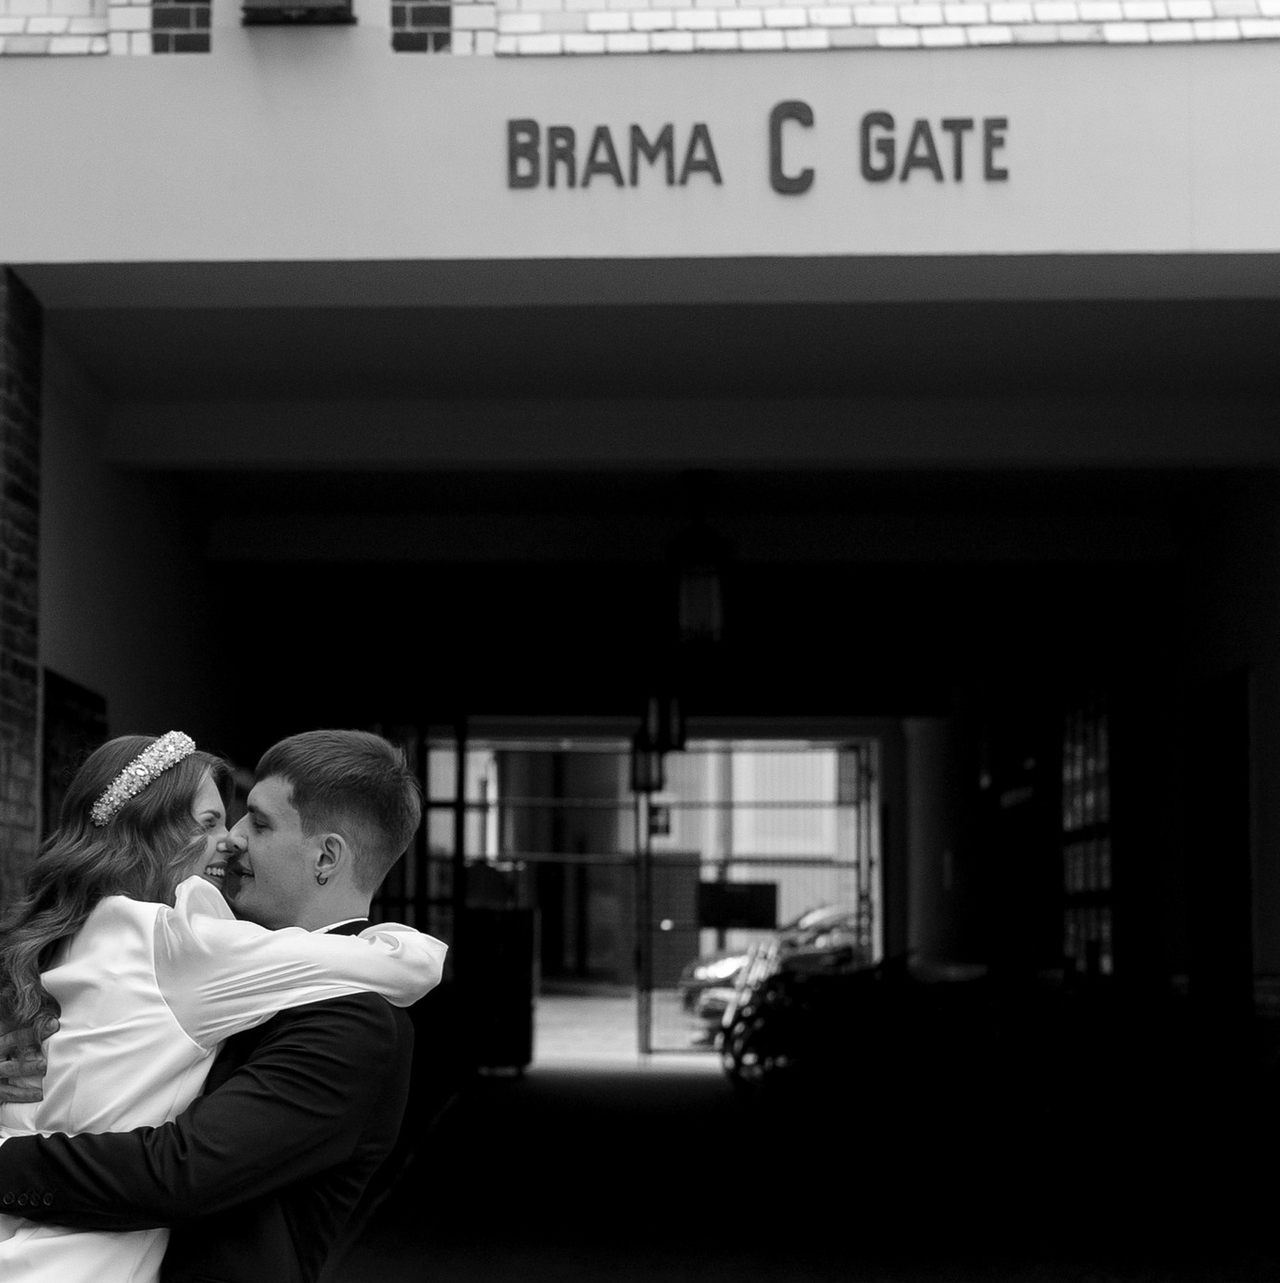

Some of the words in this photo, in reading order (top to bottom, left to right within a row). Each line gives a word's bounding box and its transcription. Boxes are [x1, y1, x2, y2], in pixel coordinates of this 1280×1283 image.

[507, 118, 723, 190] BRAMA
[768, 99, 816, 197] C
[858, 110, 1010, 184] GATE
